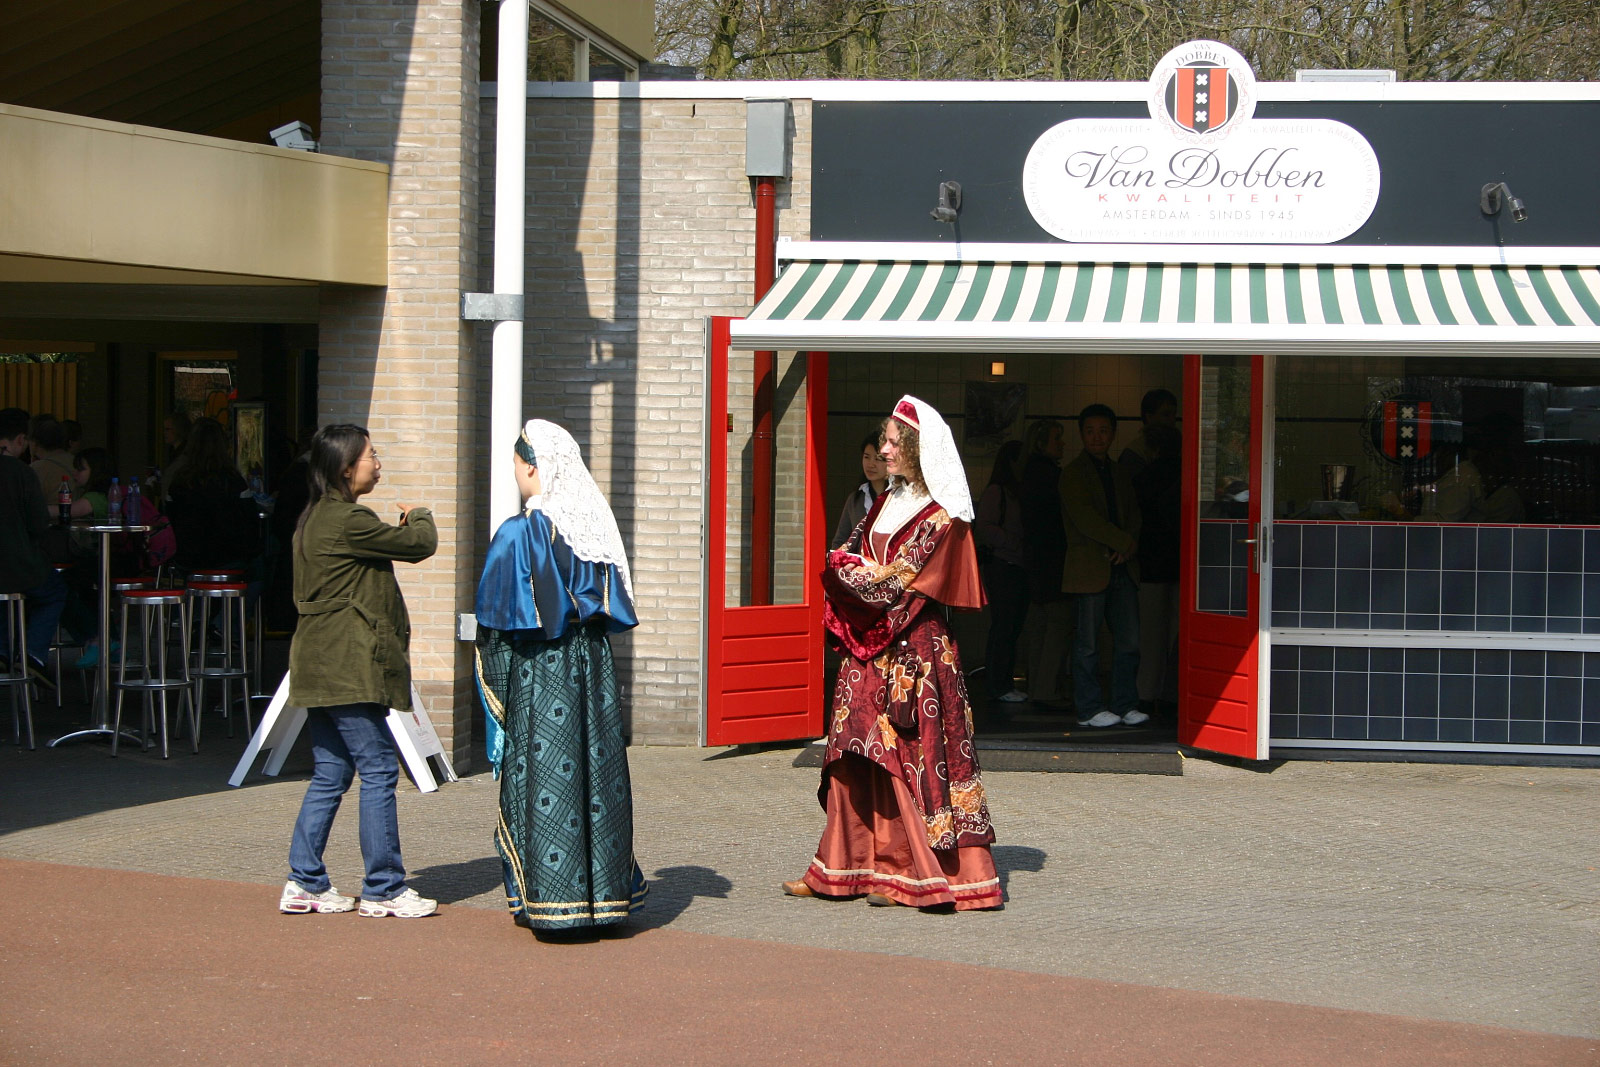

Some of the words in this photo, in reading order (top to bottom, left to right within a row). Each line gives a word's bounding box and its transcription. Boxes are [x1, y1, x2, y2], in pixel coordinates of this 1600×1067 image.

[1175, 51, 1229, 66] DOBBEN
[1064, 145, 1156, 189] Van
[1164, 147, 1326, 189] Dobben
[1098, 193, 1304, 203] KWALITEIT
[1102, 209, 1190, 221] AMSTERDAM
[1209, 209, 1252, 221] SINDS
[1260, 209, 1295, 221] 1945
